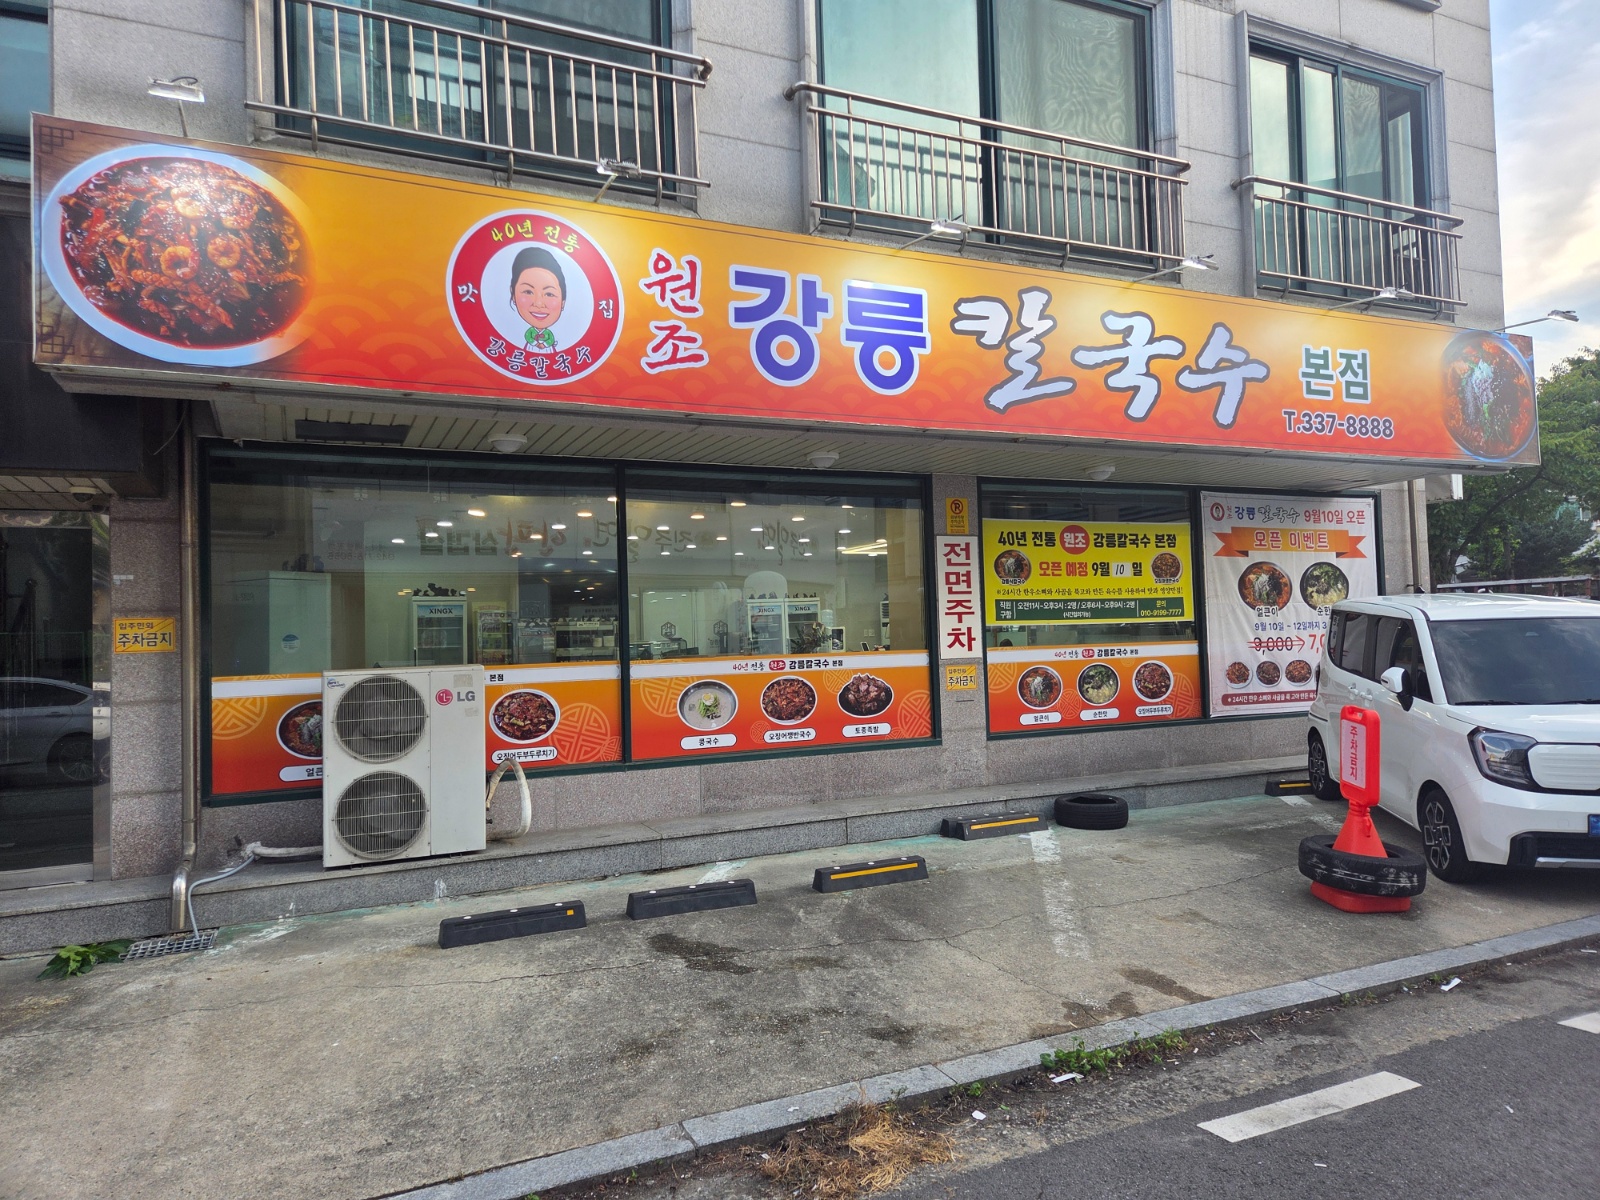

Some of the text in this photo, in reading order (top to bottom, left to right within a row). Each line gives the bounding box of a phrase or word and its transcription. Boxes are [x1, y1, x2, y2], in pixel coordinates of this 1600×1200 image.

[490, 218, 581, 253] 40년 전통
[642, 250, 708, 373] 원조
[1301, 344, 1371, 404] 본점
[1282, 410, 1395, 439] T.337-8888
[1303, 509, 1343, 524] 9월10일
[1346, 510, 1366, 524] 오픈
[998, 531, 1177, 548] 40년 전통 원조 강릉칼국수 본점
[1254, 531, 1329, 550] 오픈 이벤트
[1039, 561, 1062, 577] 오픈
[1065, 561, 1088, 577] 예정
[1092, 562, 1110, 577] 9월
[943, 541, 976, 652] 전면주차
[429, 607, 453, 615] XINGX
[1257, 607, 1278, 617] 얼큰이
[1317, 606, 1331, 616] 순한
[119, 622, 153, 630] 입주민외
[1255, 622, 1267, 631] 9월
[1269, 622, 1284, 631] 10일
[1293, 621, 1320, 631] 12일까지
[117, 632, 172, 648] 주차금지
[1097, 648, 1128, 657] 강릉칼국수
[733, 662, 749, 671] 40년
[789, 659, 829, 669] 강릉칼국수
[490, 673, 504, 682] 본점
[948, 675, 976, 686] 주차금지
[457, 690, 476, 702] LG
[1350, 725, 1358, 780] 주차금지
[305, 767, 323, 777] 얼큰
